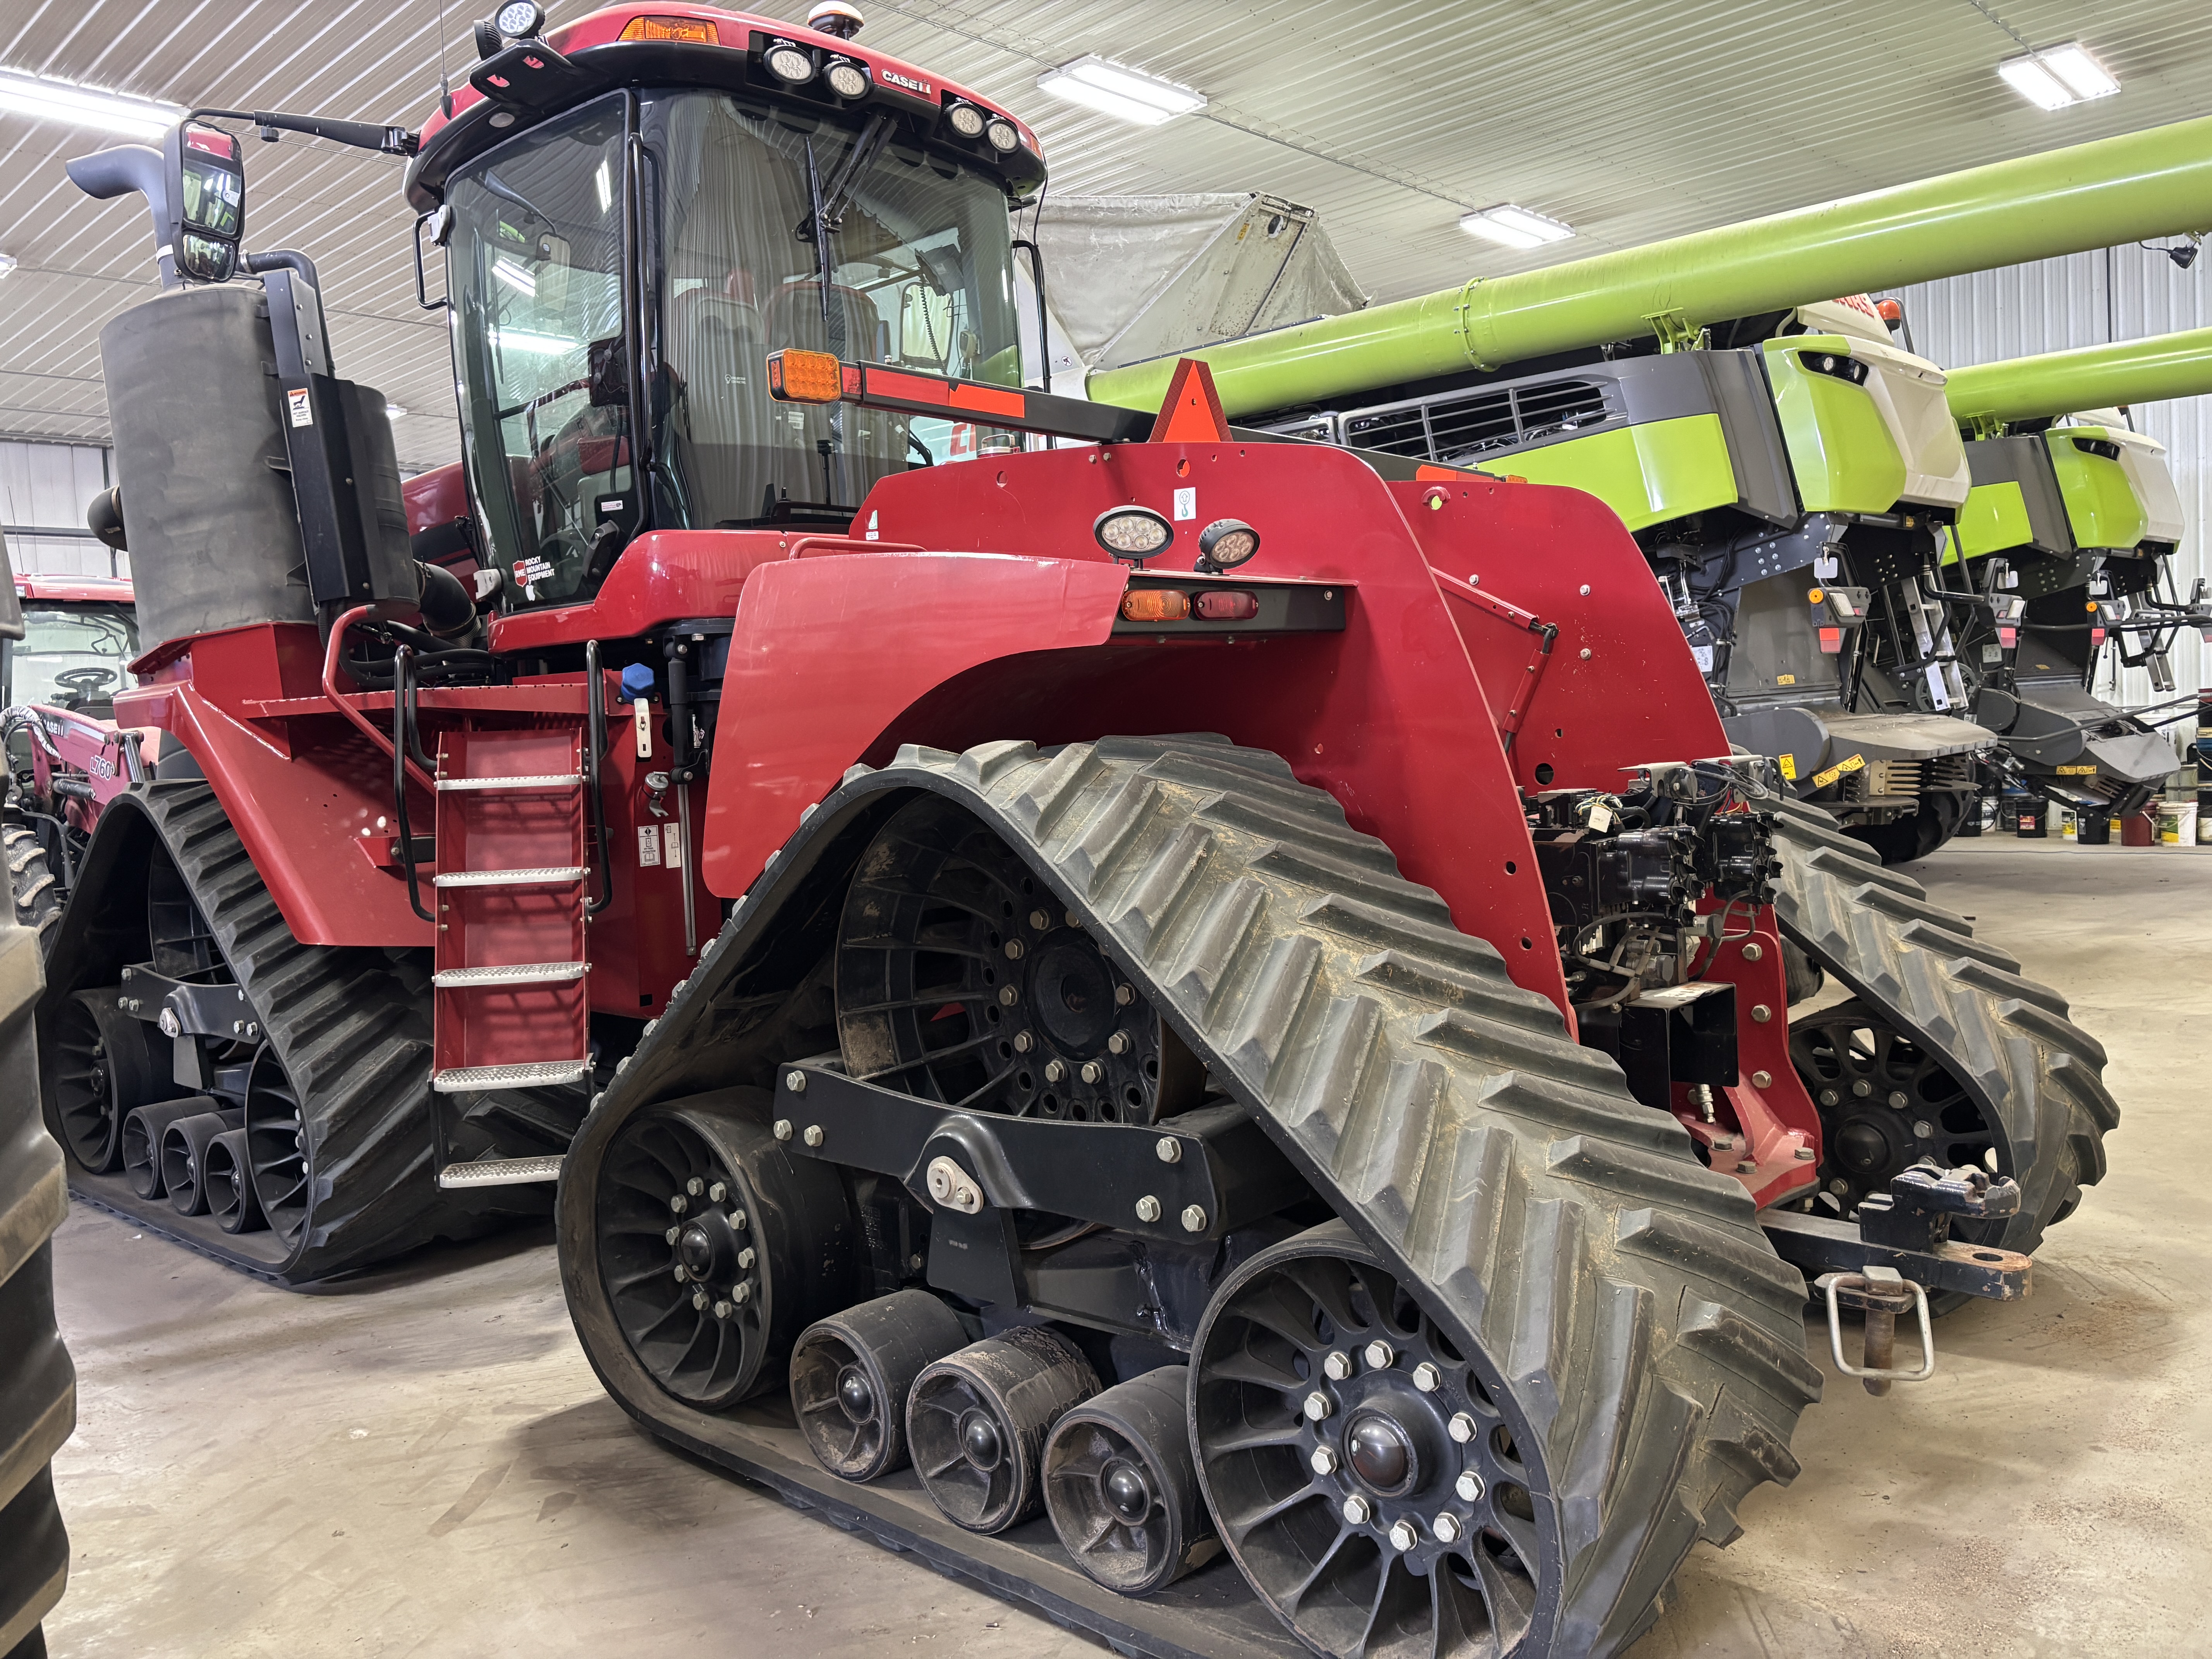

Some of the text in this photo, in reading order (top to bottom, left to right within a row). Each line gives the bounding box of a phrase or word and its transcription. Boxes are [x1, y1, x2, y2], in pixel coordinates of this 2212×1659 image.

[525, 556, 541, 567] ROCKY
[526, 562, 550, 574] MOUNTAIN
[515, 568, 526, 578] RME
[528, 568, 555, 582] EQUIPMENT
[43, 719, 57, 733] ASE
[90, 755, 112, 780] L760
